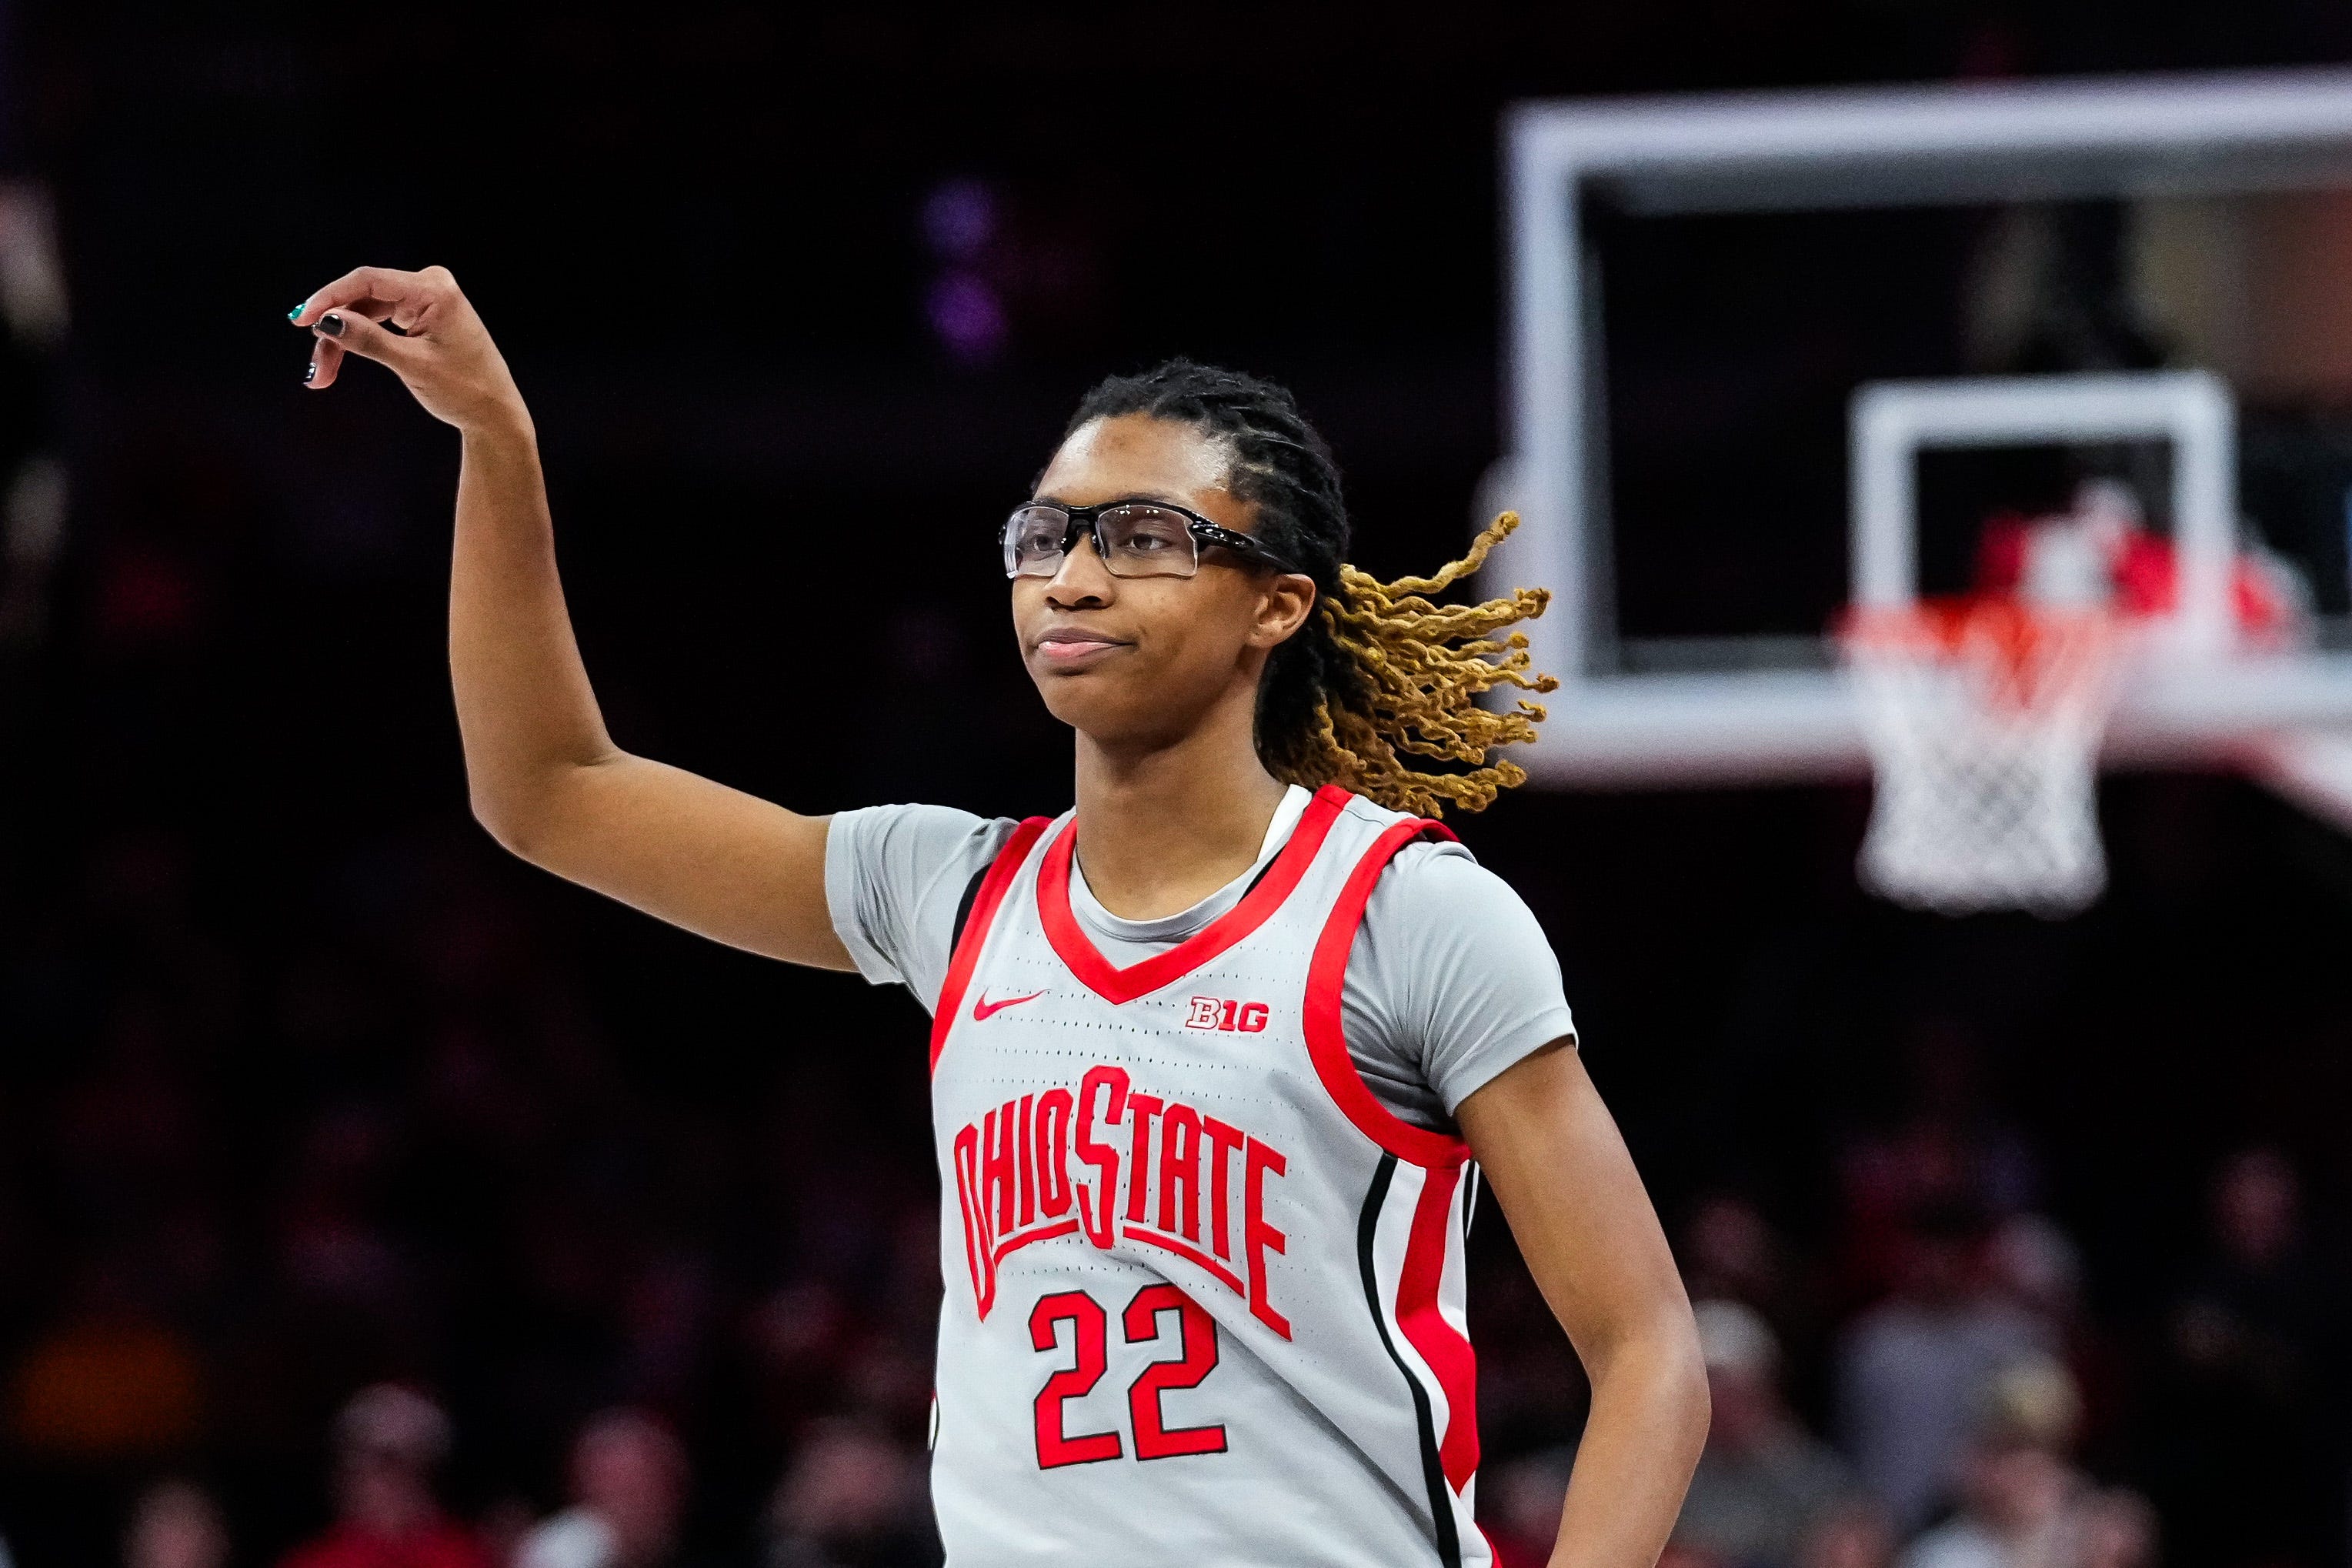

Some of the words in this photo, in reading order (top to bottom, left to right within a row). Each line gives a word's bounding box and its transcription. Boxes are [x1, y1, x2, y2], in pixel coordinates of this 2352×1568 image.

[954, 1089, 1073, 1323] OHIO
[1075, 1065, 1293, 1343] STATE
[1028, 1282, 1229, 1470] 22
